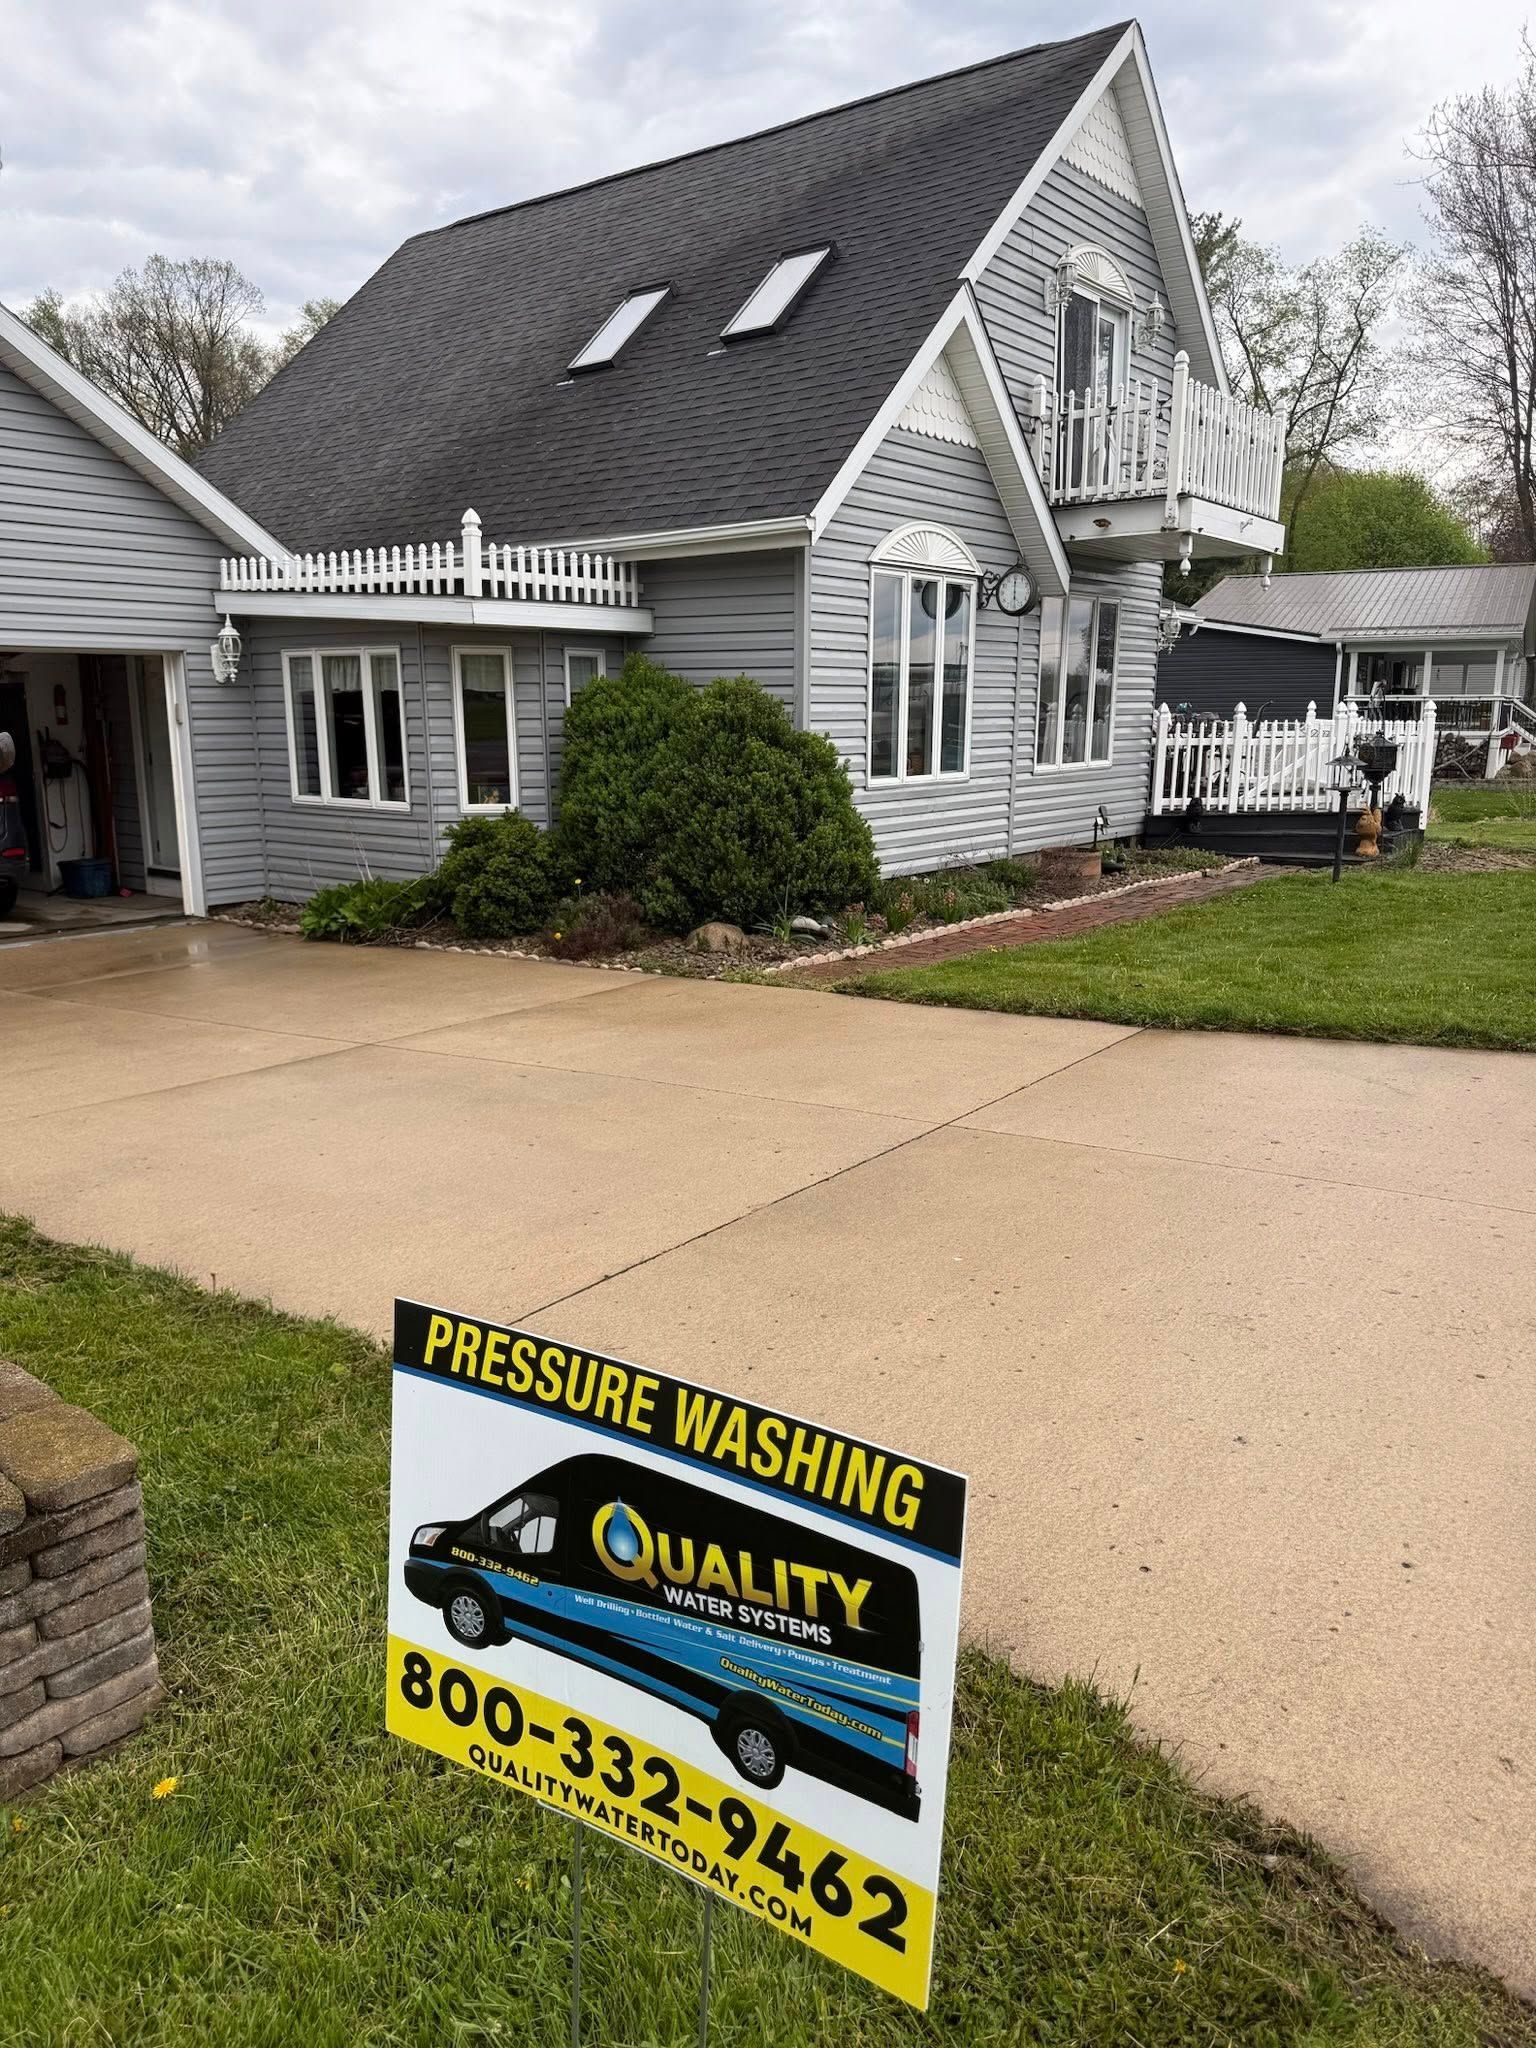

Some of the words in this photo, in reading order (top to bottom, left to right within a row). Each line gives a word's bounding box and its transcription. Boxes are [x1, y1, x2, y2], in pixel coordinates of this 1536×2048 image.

[424, 1314, 660, 1434] PRESSURE
[674, 1387, 925, 1531] WASHING
[450, 1546, 540, 1586] 800-332-9462
[592, 1501, 873, 1629] QUALITY
[663, 1584, 734, 1620] WATER
[738, 1605, 833, 1646] SYSTEMS
[574, 1594, 594, 1606] Well
[596, 1599, 630, 1616] Drilling
[635, 1608, 671, 1625] Bottled
[673, 1618, 703, 1633] Water
[705, 1626, 713, 1637] &
[716, 1629, 736, 1643] Salt
[739, 1636, 782, 1656] Delivery
[787, 1649, 825, 1668] Pumps
[832, 1660, 892, 1686] Treatment
[719, 1657, 882, 1740] QualityWaterToday.com
[400, 1651, 908, 1955] 800-332-9462
[468, 1744, 812, 1938] QUALITYWATERTODAY.COM
